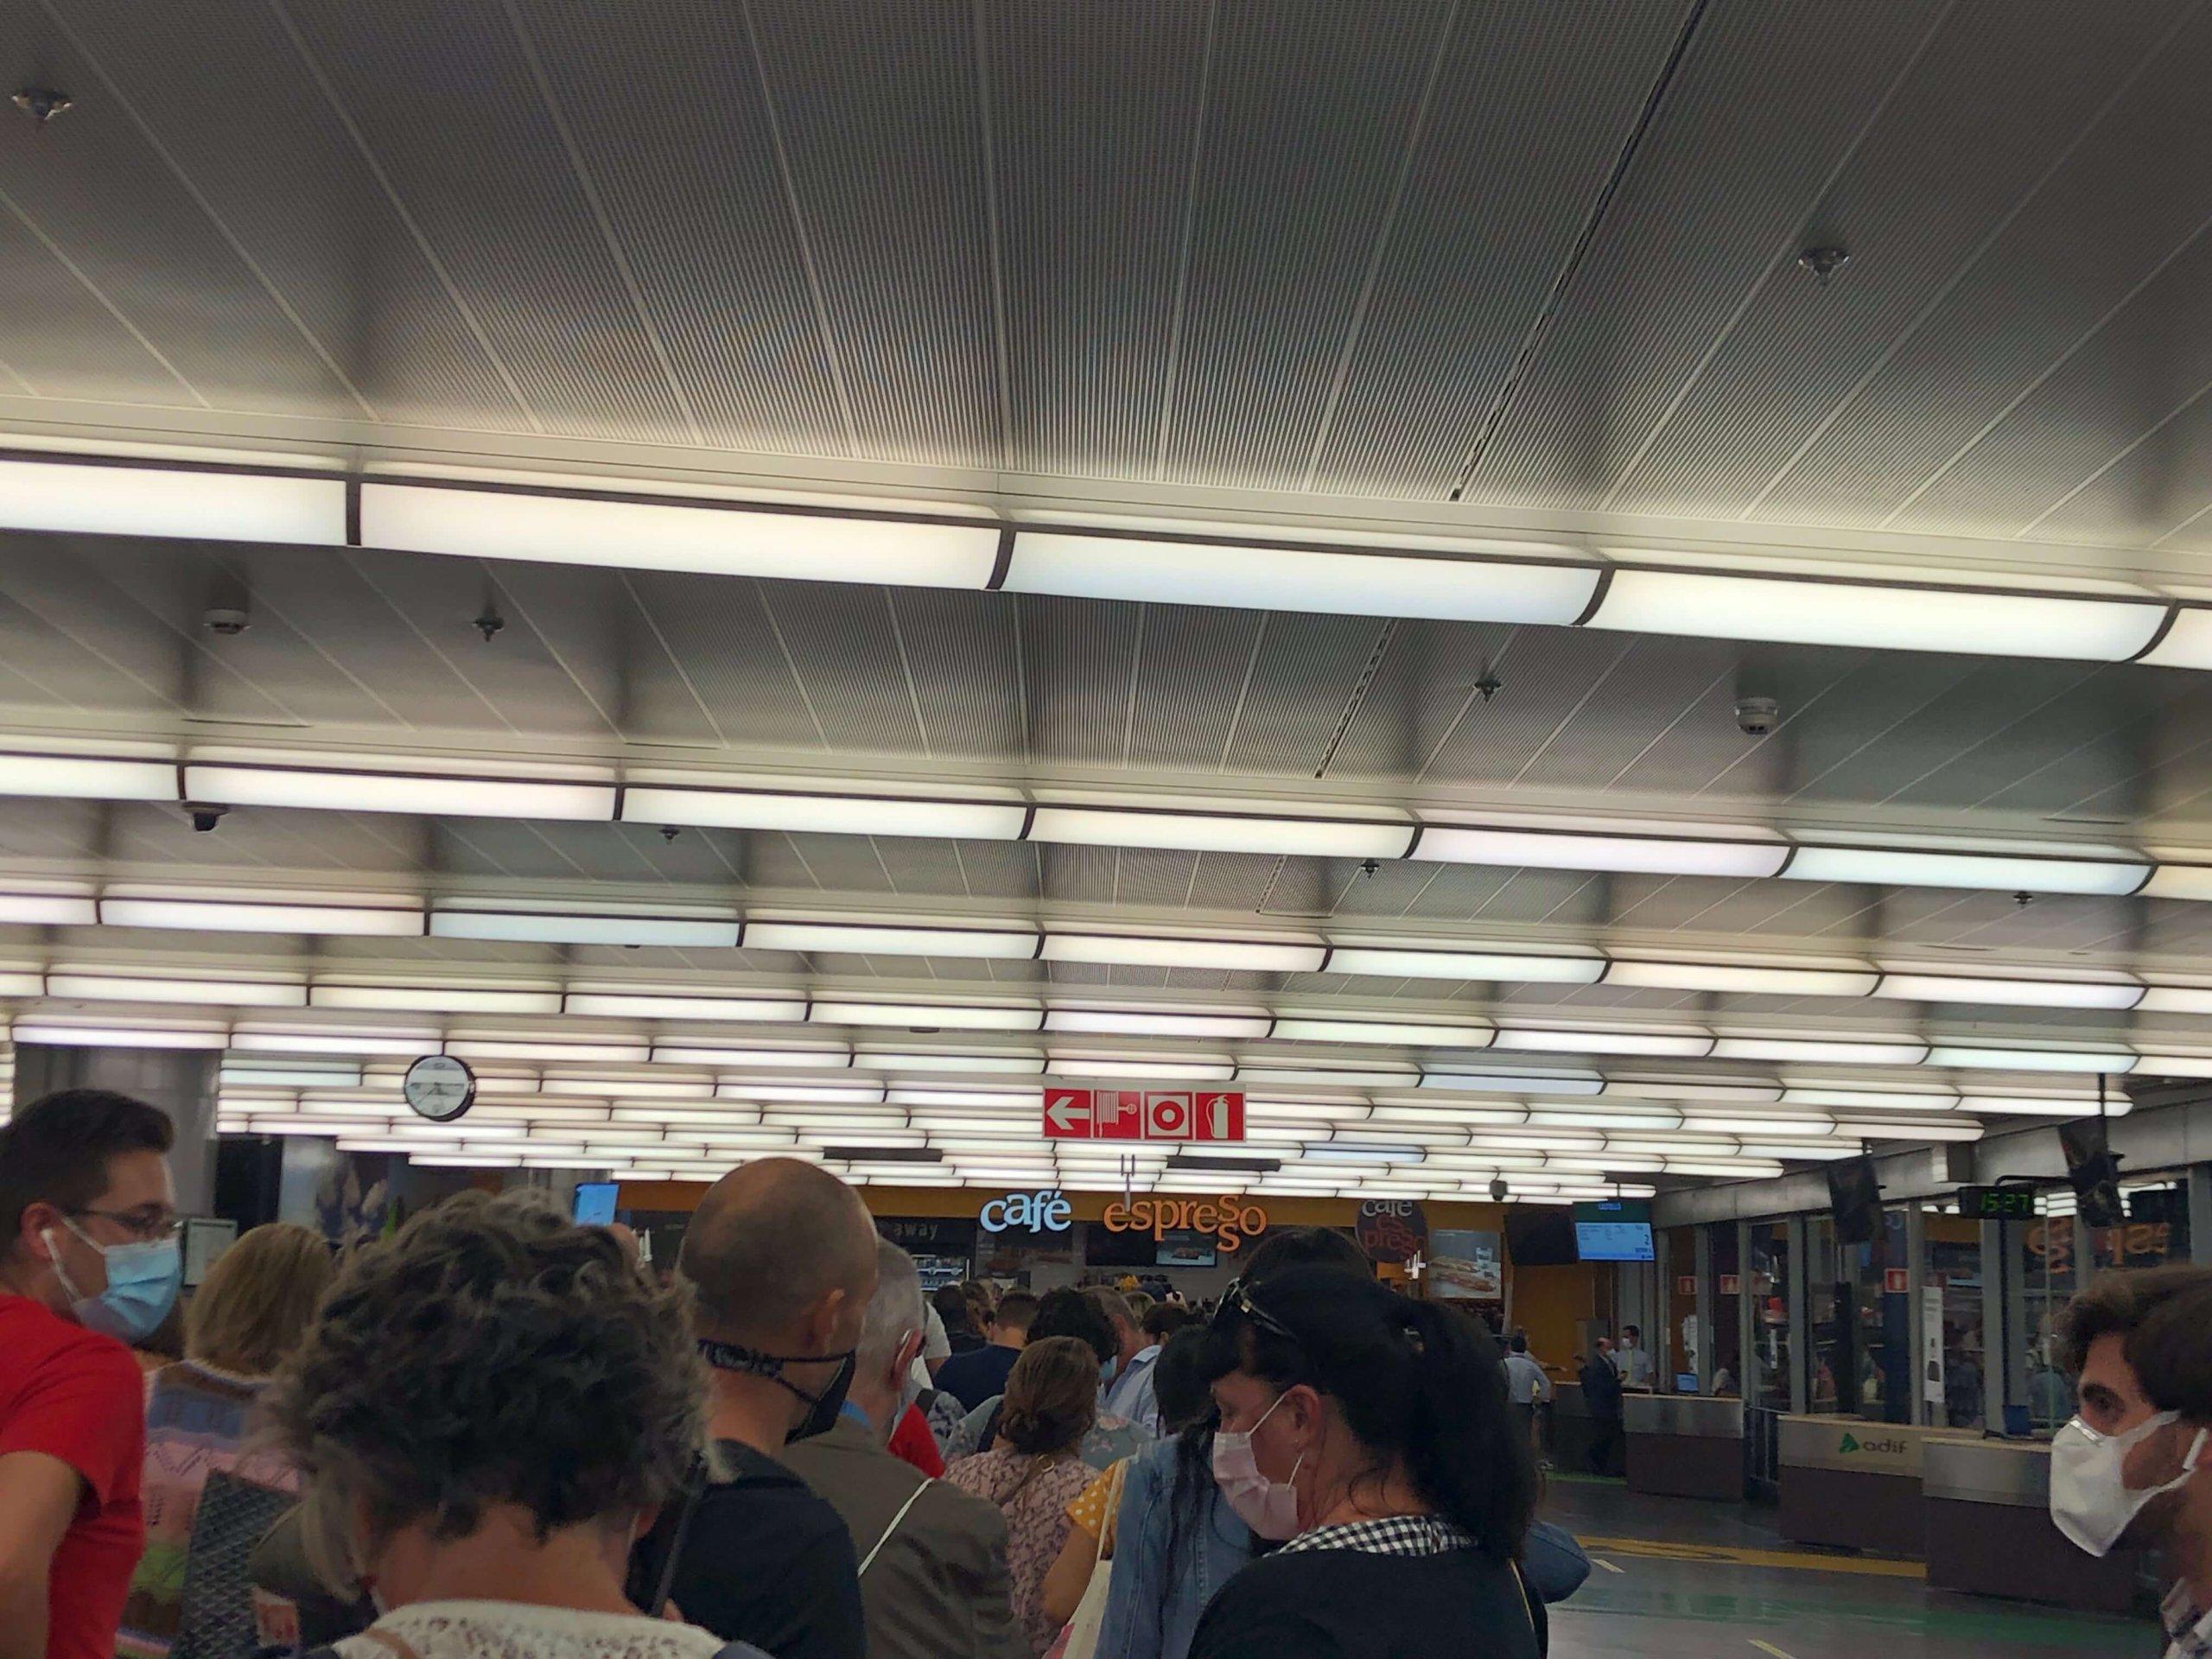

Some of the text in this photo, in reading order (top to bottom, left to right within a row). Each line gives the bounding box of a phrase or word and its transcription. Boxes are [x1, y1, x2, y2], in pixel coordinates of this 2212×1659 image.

[980, 1191, 1267, 1252] café espresso
[893, 1224, 938, 1241] away
[1863, 1439, 1908, 1453] adif
